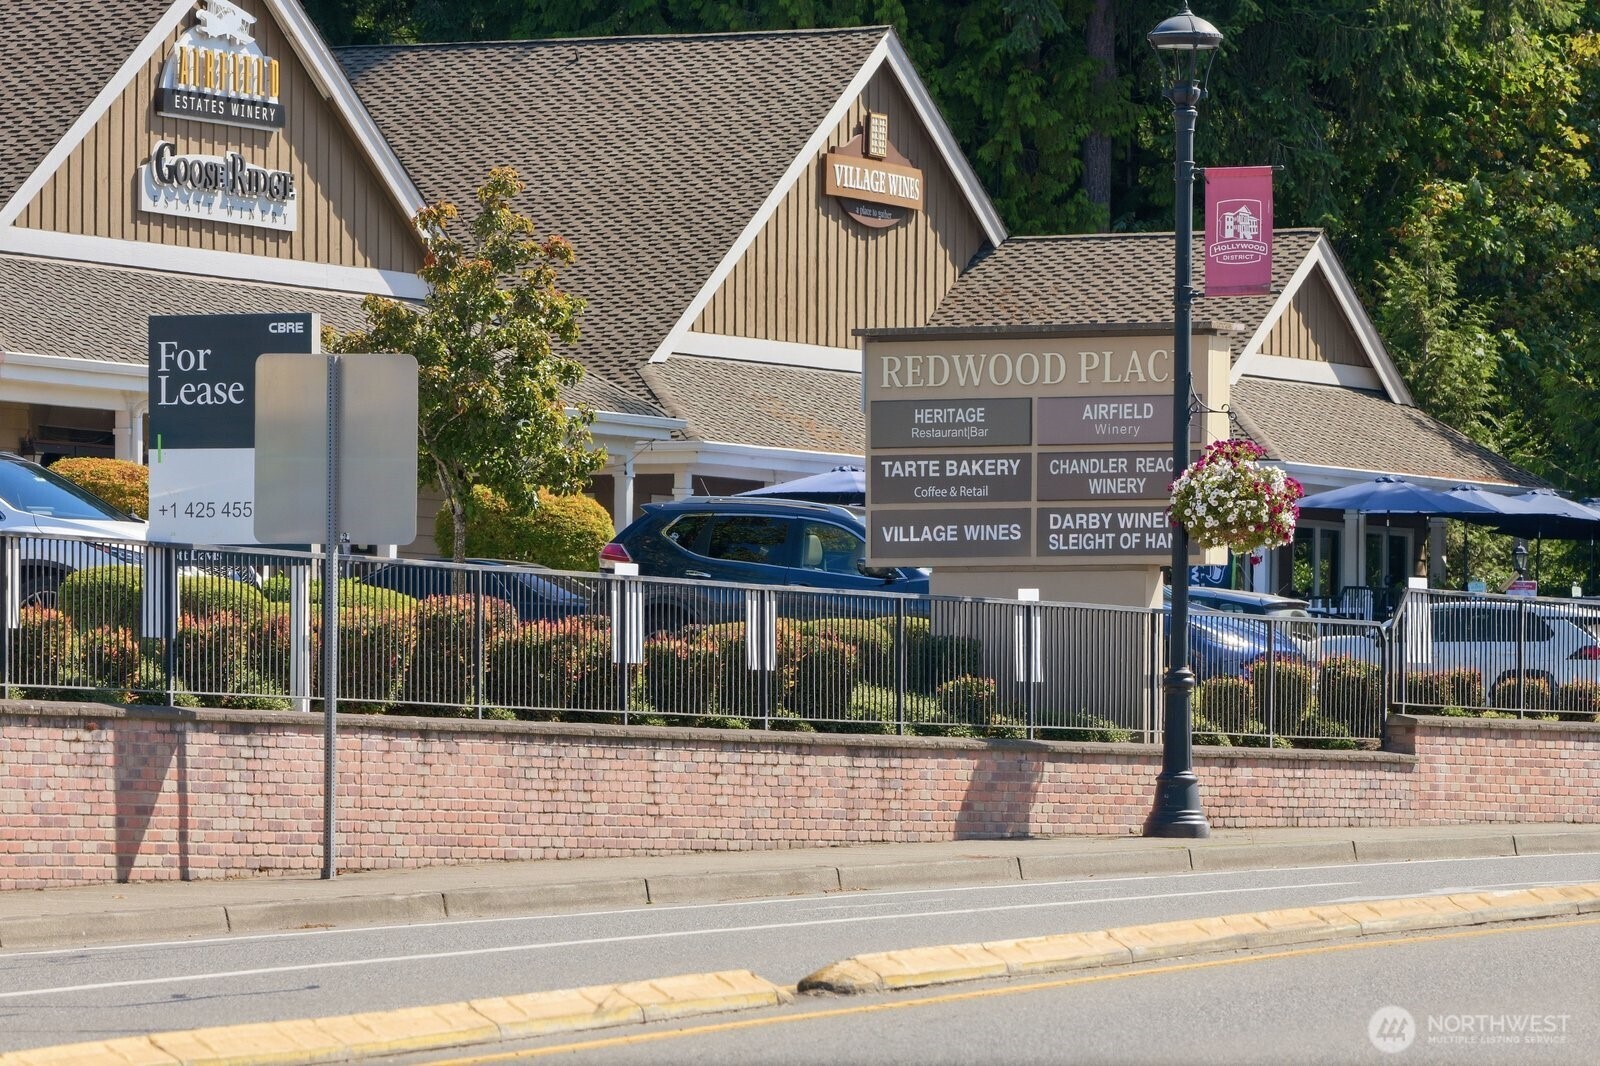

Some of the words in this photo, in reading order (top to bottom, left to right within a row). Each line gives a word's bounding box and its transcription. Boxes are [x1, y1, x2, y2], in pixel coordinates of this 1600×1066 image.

[178, 46, 280, 98] AIRFIELD
[174, 94, 224, 115] ESTATES
[231, 103, 276, 122] WINERY
[154, 141, 226, 190] GOOSE
[229, 152, 295, 201] RIDGE
[834, 164, 886, 194] VILLAGE
[888, 173, 920, 201] WINES
[152, 194, 213, 216] ESTATE
[226, 205, 288, 226] WINERY
[1213, 243, 1266, 253] HOLLYWOOD
[268, 322, 304, 334] CBRE
[158, 341, 211, 372] For
[880, 351, 1066, 389] REDWOOD
[1078, 349, 1175, 385] PLAC
[158, 376, 245, 406] Lease
[914, 408, 986, 424] HERITAGE
[1082, 403, 1154, 421] AIRFIELD
[1094, 423, 1141, 437] Winery
[881, 460, 940, 478] TARTE
[946, 458, 1021, 477] BAKERY
[1049, 458, 1128, 476] CHANDLER
[1136, 456, 1174, 473] REAC
[914, 486, 948, 498] Coffee
[949, 486, 958, 497] &
[960, 485, 989, 497] Retail
[1088, 477, 1146, 495] WINERY
[158, 502, 177, 518] +1
[184, 502, 216, 518] 425
[221, 501, 252, 518] 455
[1049, 512, 1112, 530] DARBY
[1117, 512, 1170, 529] WINE
[882, 525, 958, 542] VILLAGE
[963, 524, 1022, 542] WINES
[1049, 533, 1114, 550] SLEIGHT
[1120, 532, 1141, 550] OF
[1146, 532, 1174, 549] HAN
